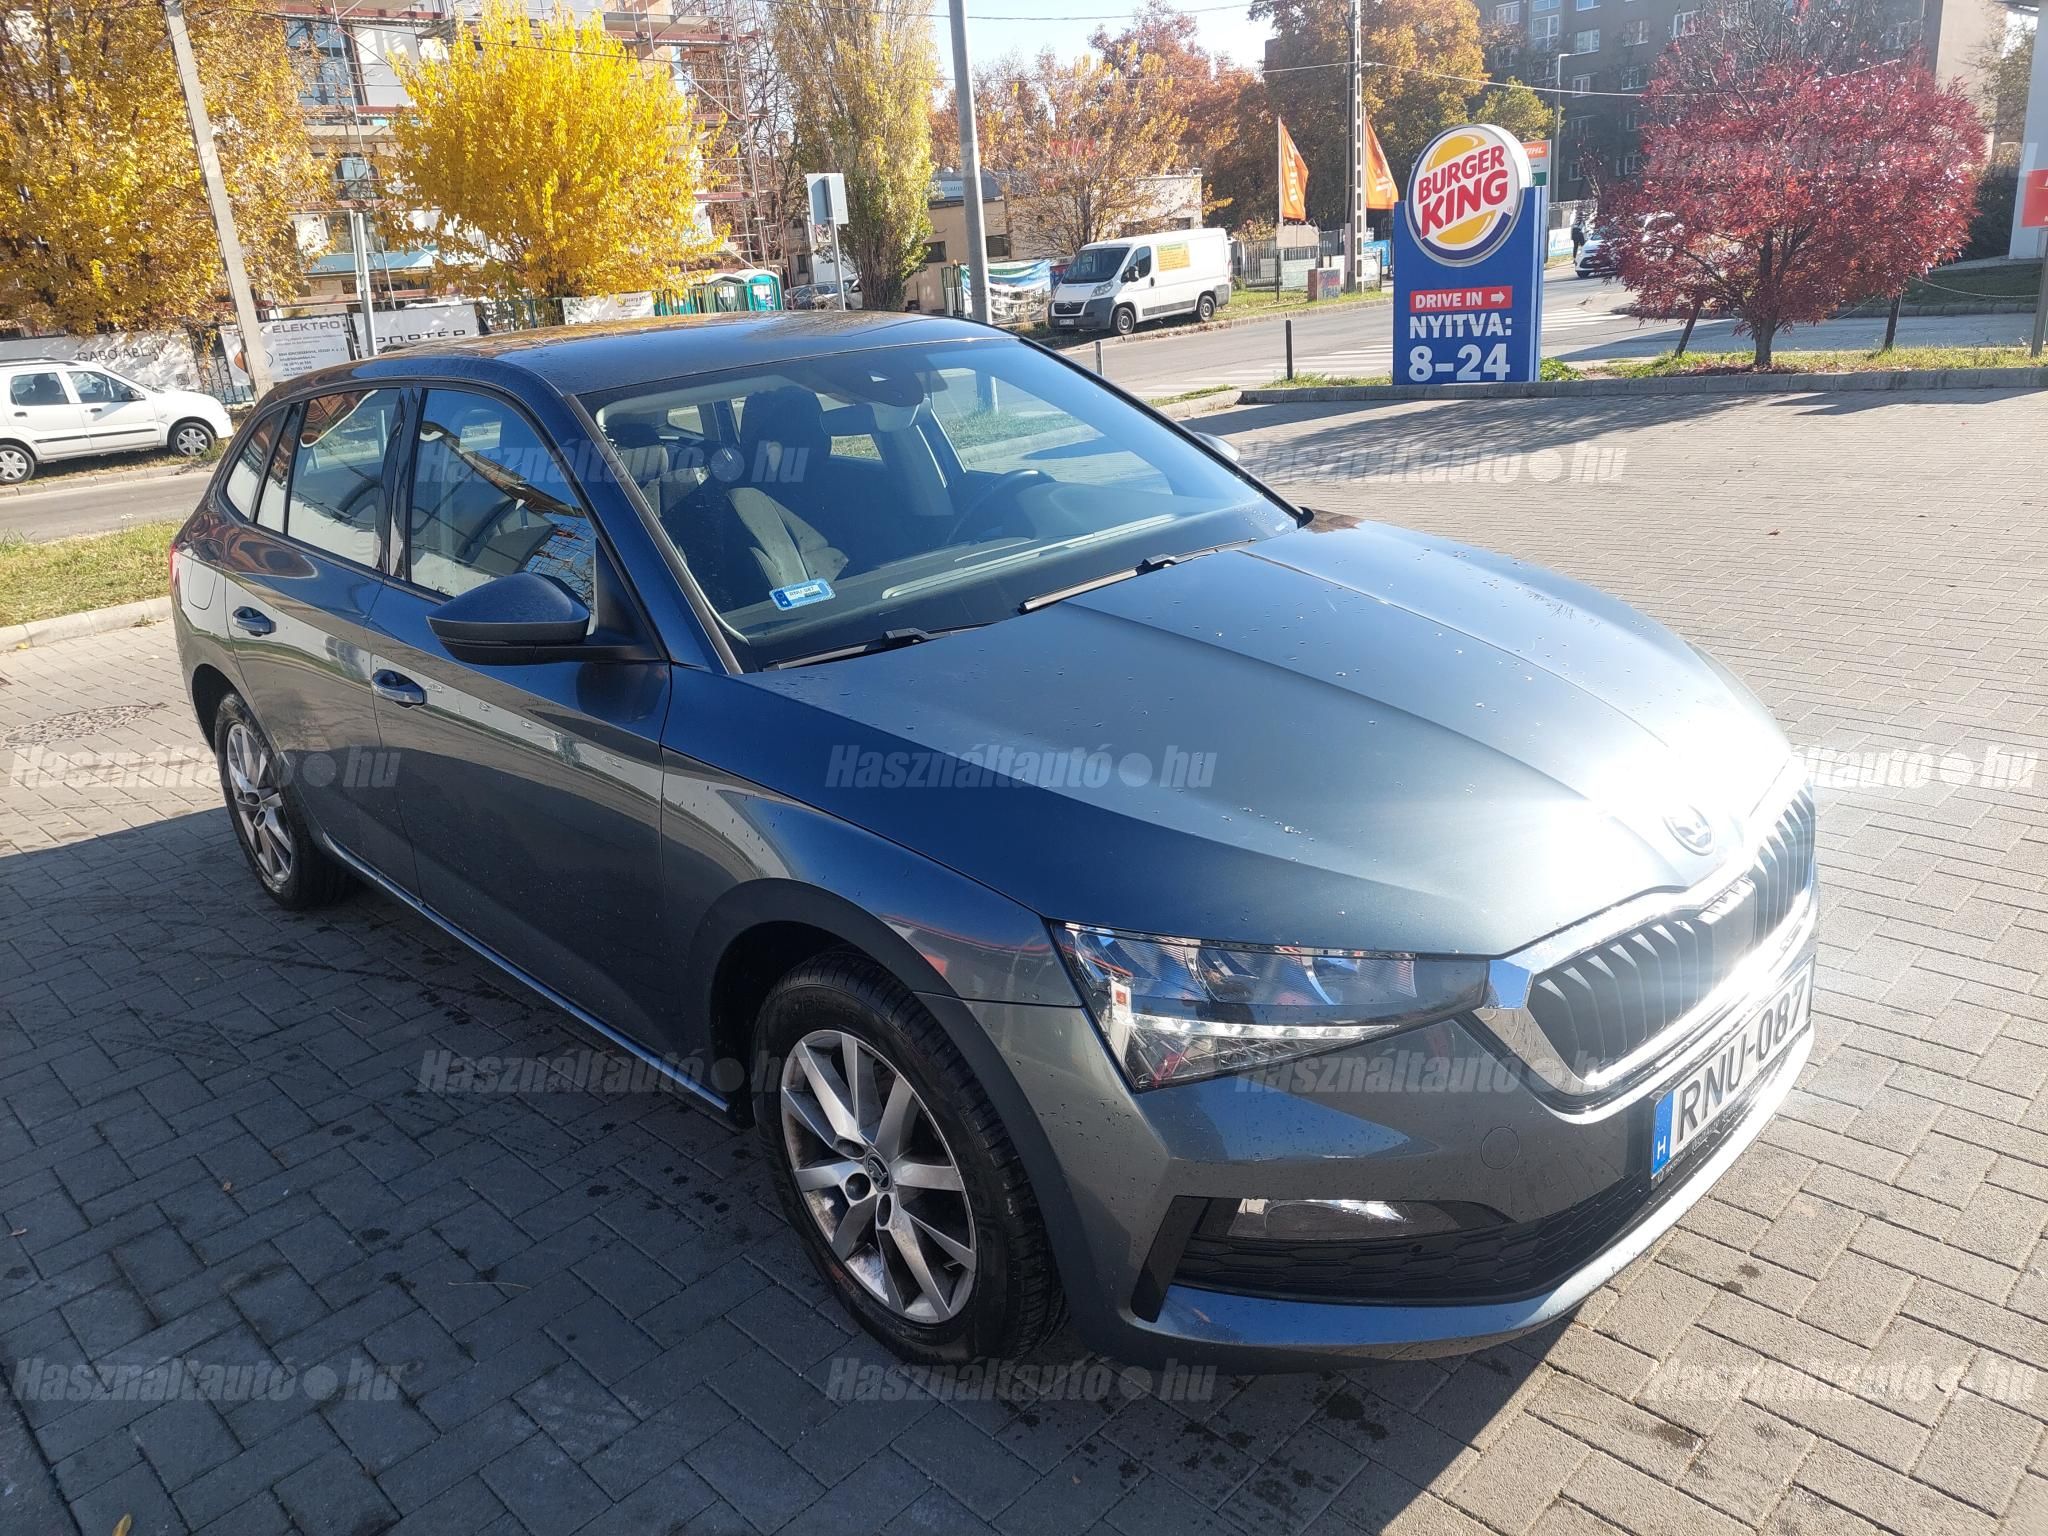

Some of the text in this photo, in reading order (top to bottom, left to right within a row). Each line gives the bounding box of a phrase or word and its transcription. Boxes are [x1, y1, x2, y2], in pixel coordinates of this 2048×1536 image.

[1418, 145, 1505, 205] BURGER
[1421, 169, 1508, 239] KING
[1415, 291, 1483, 309] DRIVE IN
[272, 320, 341, 334] ELEKTRO
[1409, 312, 1512, 339] NYITVA:
[1408, 343, 1511, 383] 8-24
[1677, 973, 1808, 1144] RNU-087
[1656, 1135, 1667, 1160] H
